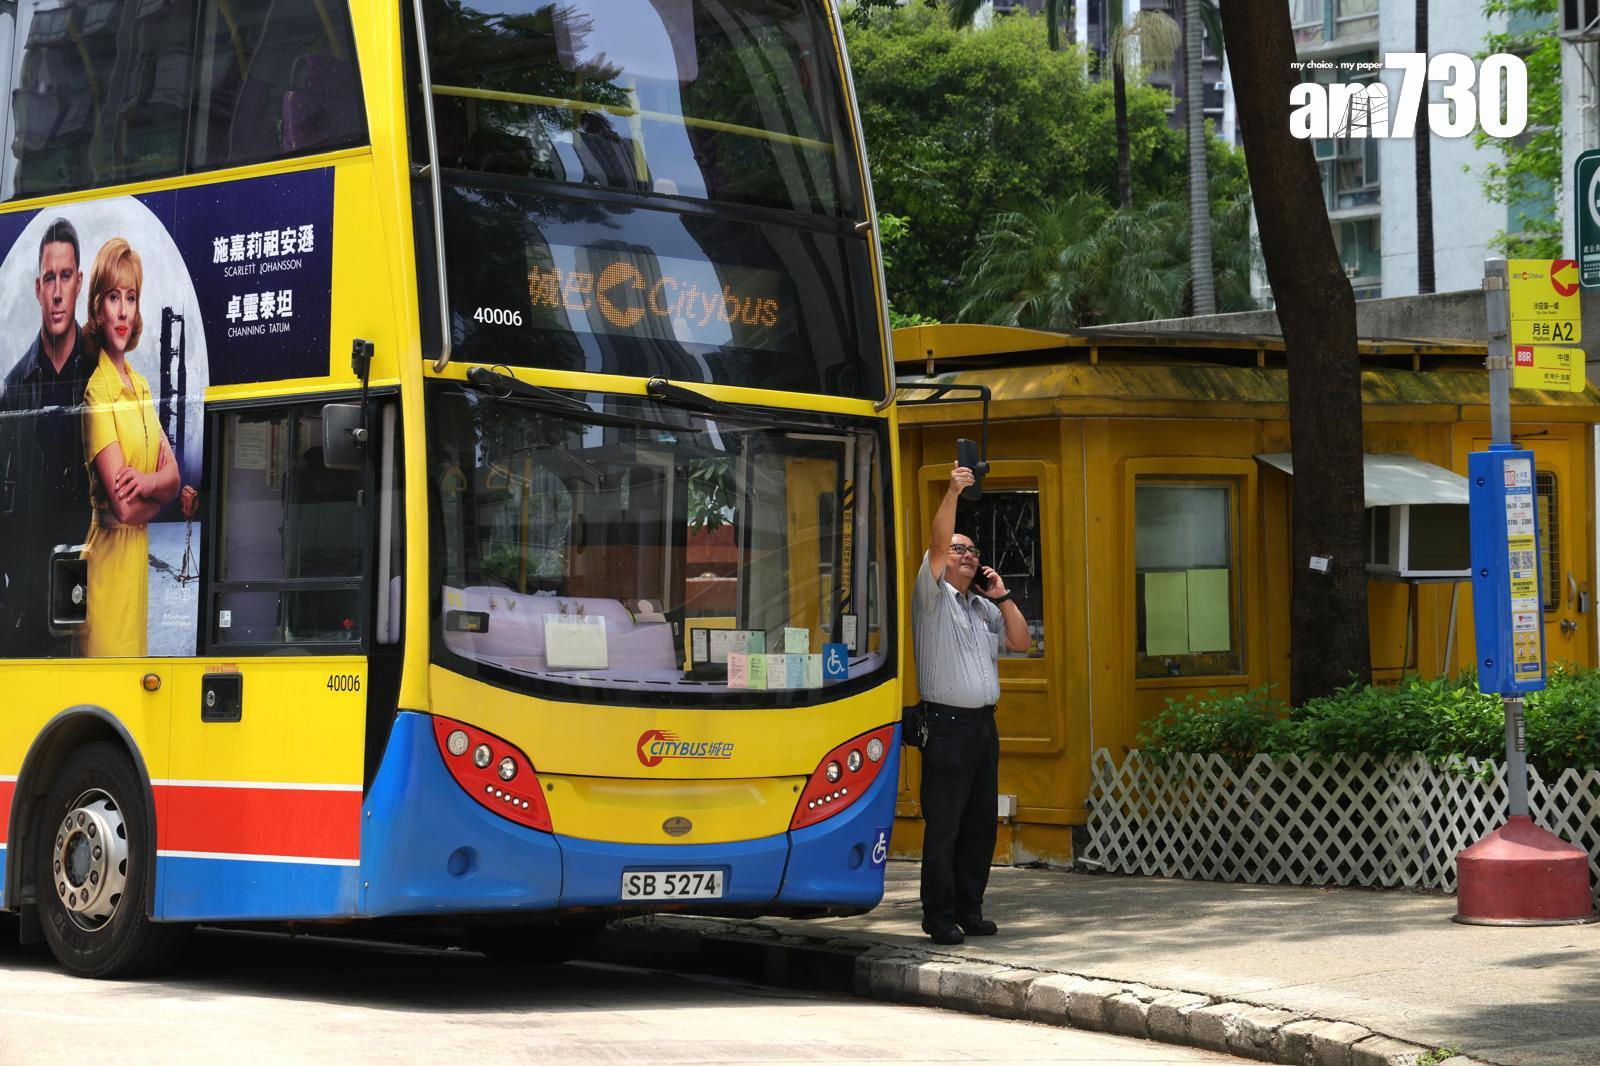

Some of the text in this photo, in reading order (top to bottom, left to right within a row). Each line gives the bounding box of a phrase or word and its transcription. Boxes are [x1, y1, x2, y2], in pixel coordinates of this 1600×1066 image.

[213, 224, 314, 264] 施嘉莉祖安遜
[224, 259, 302, 277] SCARLETT JOHANSSON
[226, 289, 293, 323] 卓靈泰坦
[650, 275, 779, 327] Citybus
[473, 306, 523, 327] 40006
[228, 322, 290, 338] CHANNING TATUM
[1533, 323, 1550, 335] 月台
[1552, 322, 1574, 341] A2
[1517, 351, 1532, 362] 88R
[327, 674, 361, 692] 40006
[650, 741, 734, 757] CITYBUS 城巴
[628, 873, 716, 896] SB 5274
